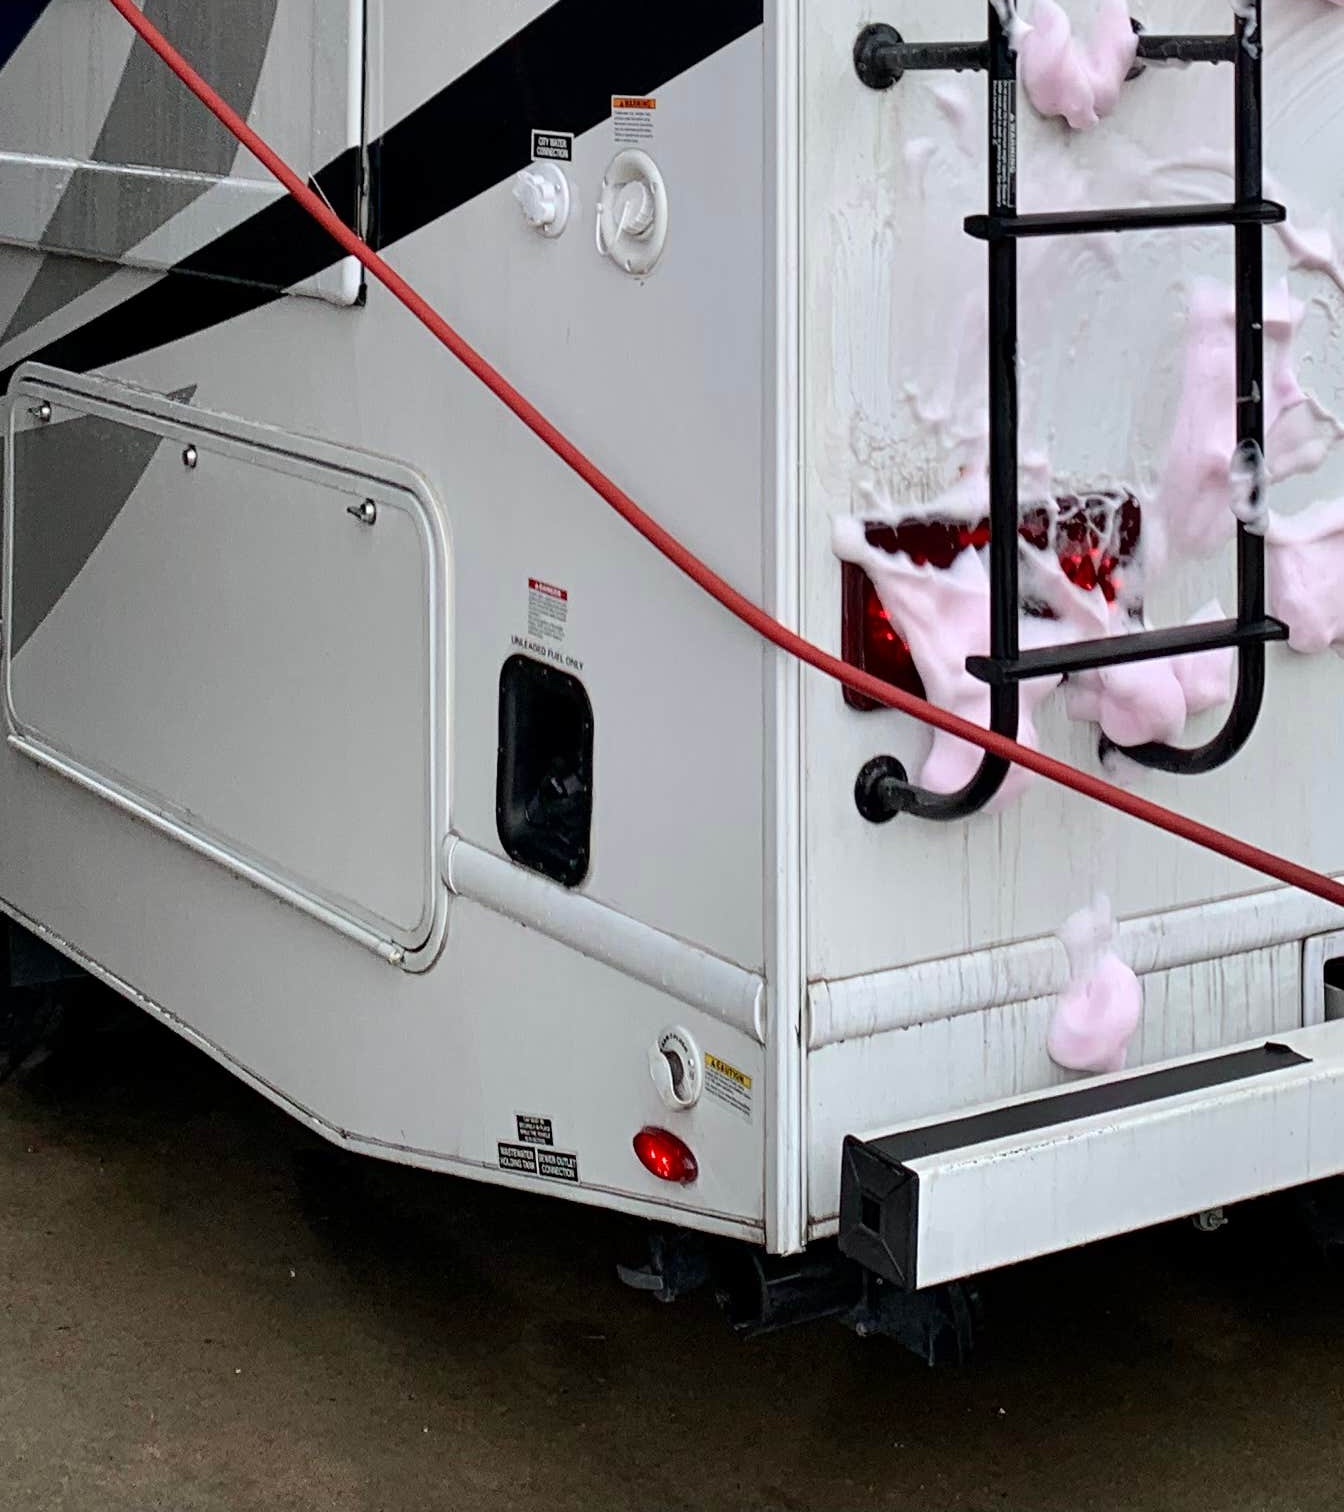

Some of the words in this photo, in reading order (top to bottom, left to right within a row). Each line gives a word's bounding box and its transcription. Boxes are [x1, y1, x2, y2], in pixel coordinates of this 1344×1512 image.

[511, 634, 546, 656] UNLEADED
[547, 649, 564, 664] FUEL
[565, 656, 584, 670] ONLY
